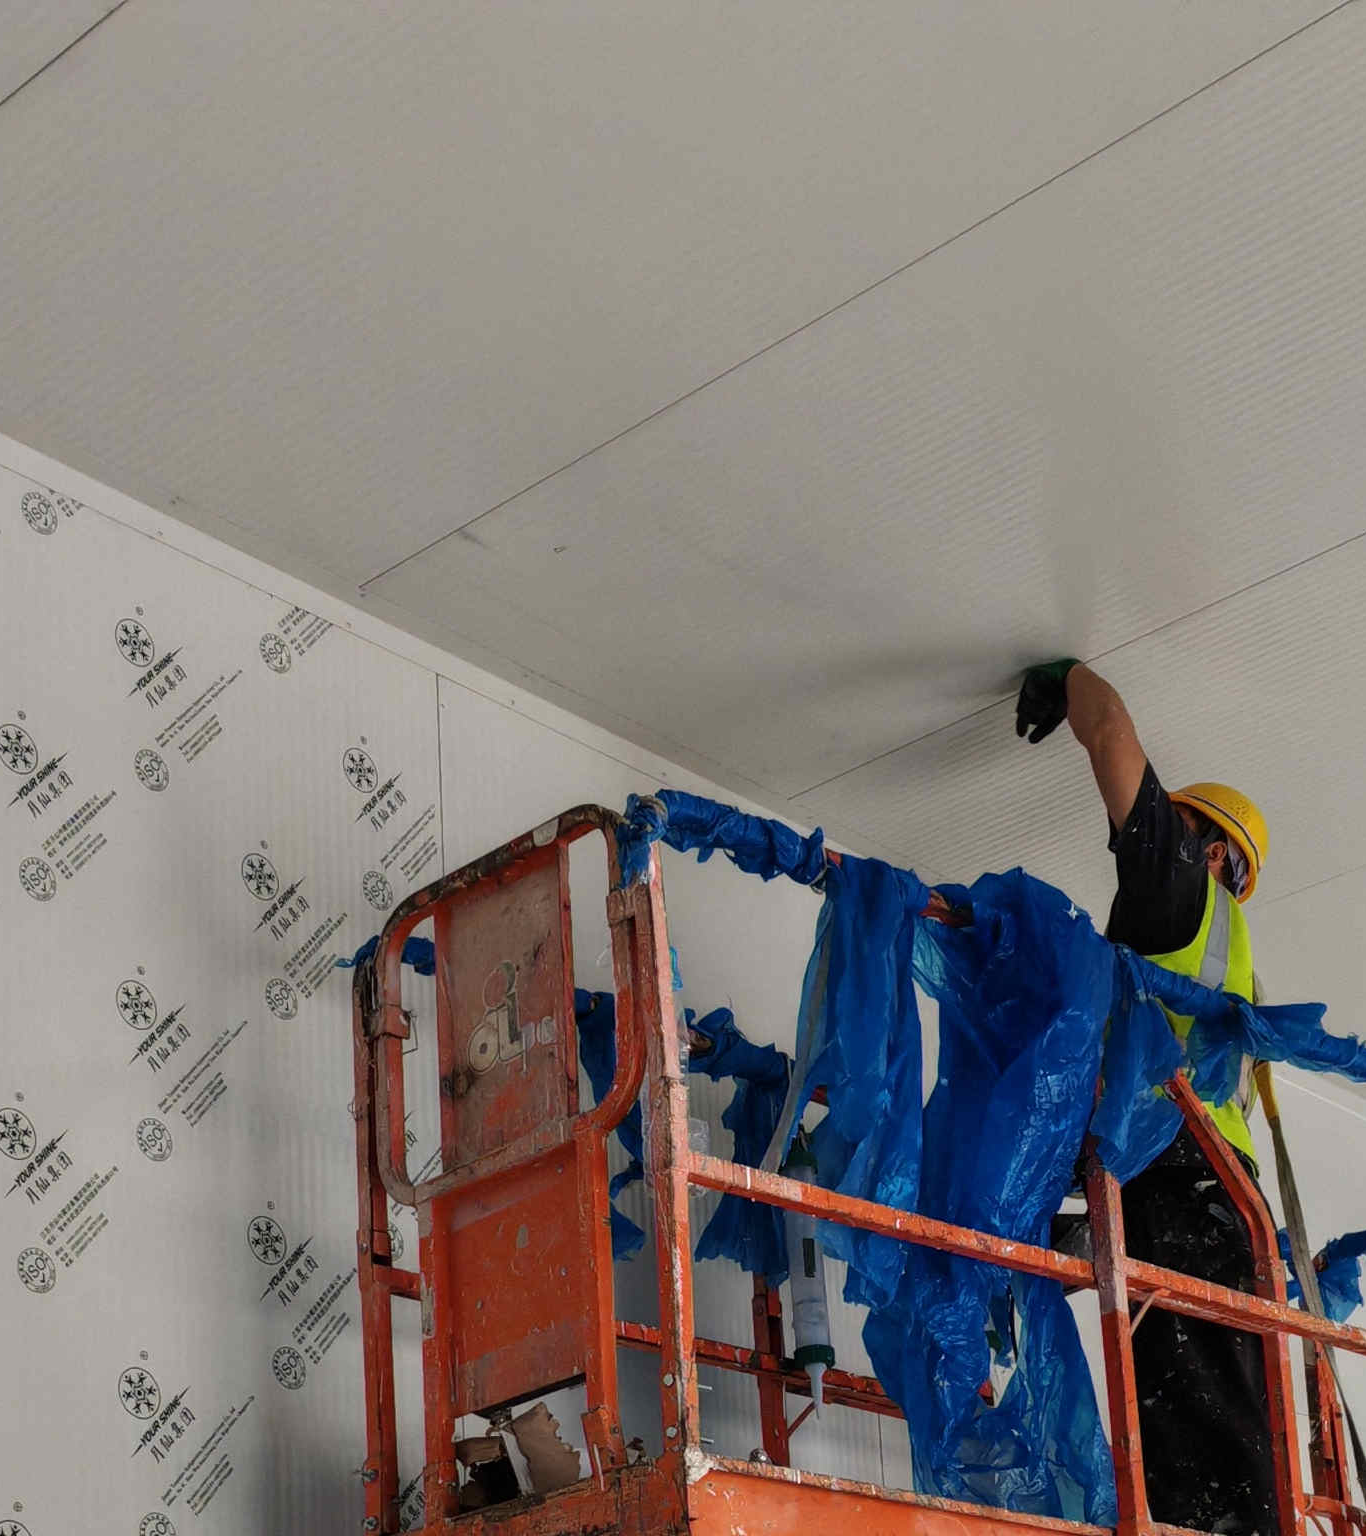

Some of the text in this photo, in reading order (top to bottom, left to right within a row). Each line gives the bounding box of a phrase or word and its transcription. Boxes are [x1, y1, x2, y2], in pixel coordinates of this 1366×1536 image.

[16, 758, 58, 799] YOUR SHINE
[24, 864, 48, 889] ISO
[14, 1138, 58, 1187] YOUR SHINE
[22, 1254, 47, 1281] ISO
